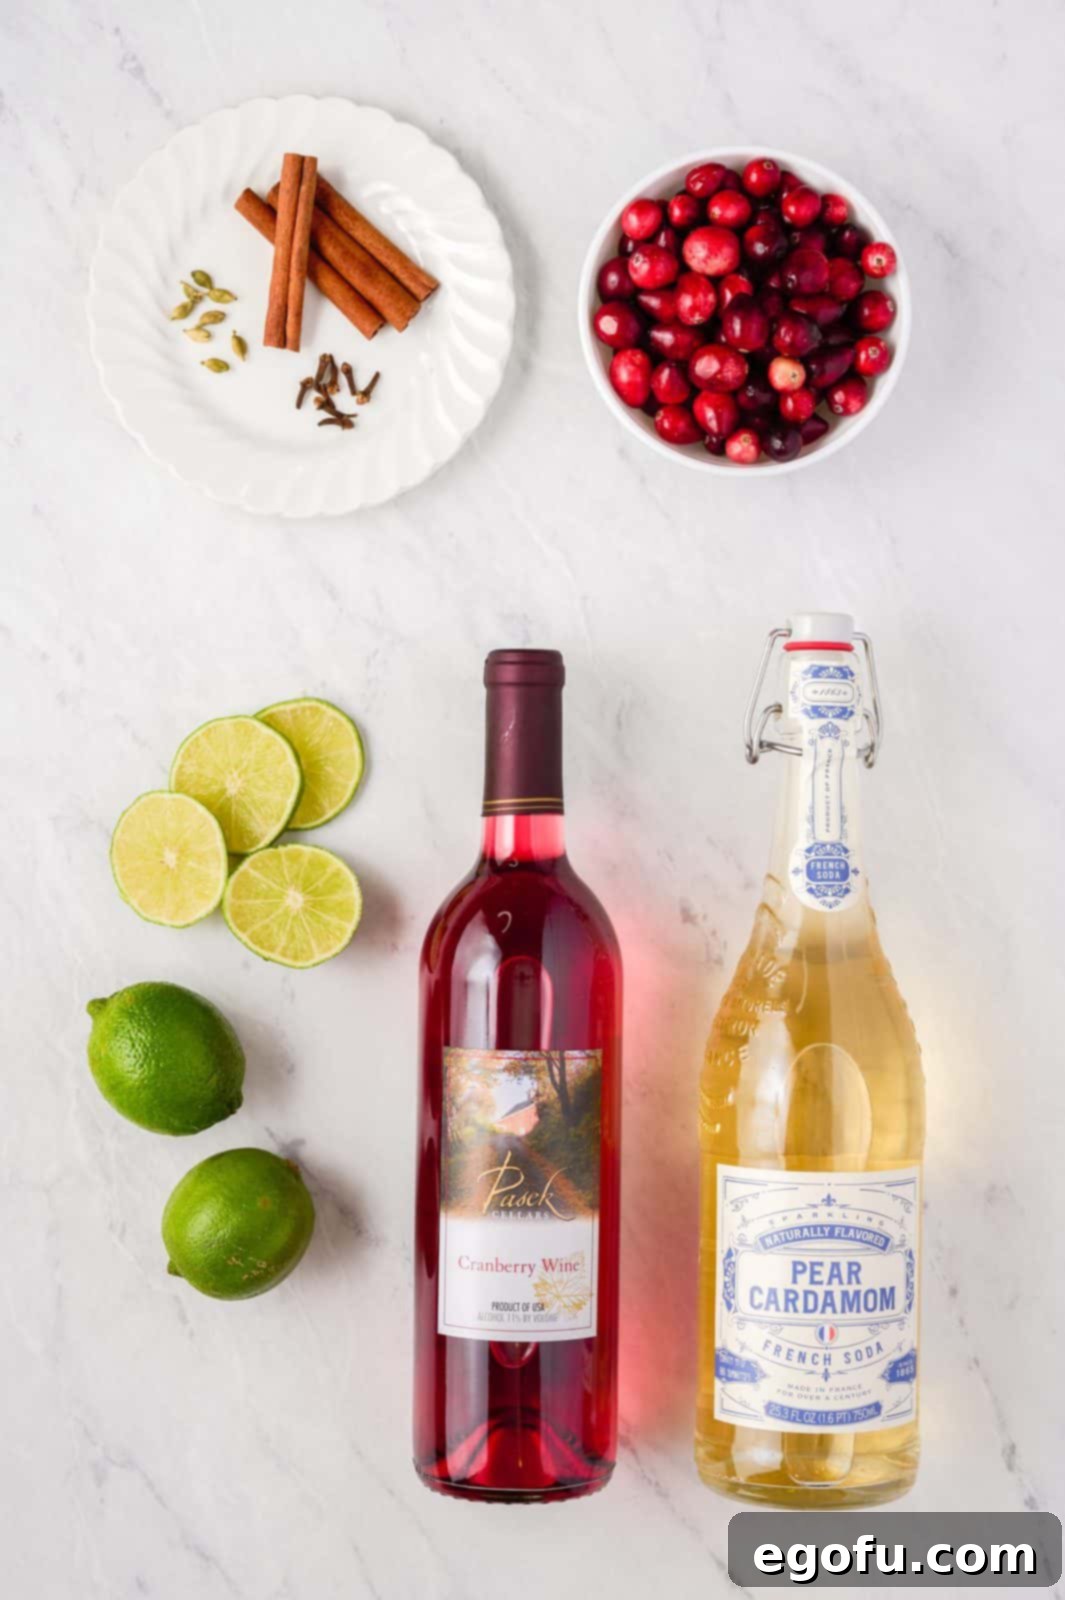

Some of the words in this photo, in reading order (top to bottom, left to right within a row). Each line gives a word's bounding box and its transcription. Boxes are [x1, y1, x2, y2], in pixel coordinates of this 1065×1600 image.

[810, 861, 846, 870] FRENCH
[816, 870, 840, 880] SODA
[769, 1211, 885, 1227] SPARKLING
[764, 1226, 831, 1247] NATURALLY
[834, 1226, 885, 1246] FLAVORED
[457, 1255, 536, 1279] Cranberry
[541, 1257, 581, 1273] Wine
[791, 1260, 862, 1286] PEAR
[491, 1301, 520, 1312] PRODUCT
[521, 1302, 530, 1312] OF
[532, 1302, 545, 1312] USA
[750, 1286, 896, 1315] CARDAMOM
[763, 1339, 832, 1366] FRENCH
[843, 1341, 884, 1364] SODA
[777, 1389, 794, 1397] FOR
[834, 1389, 872, 1400] CENTURY
[787, 1384, 811, 1392] MADE
[829, 1384, 862, 1393] FRANCE
[790, 1409, 802, 1422] FL
[803, 1412, 817, 1424] OZ
